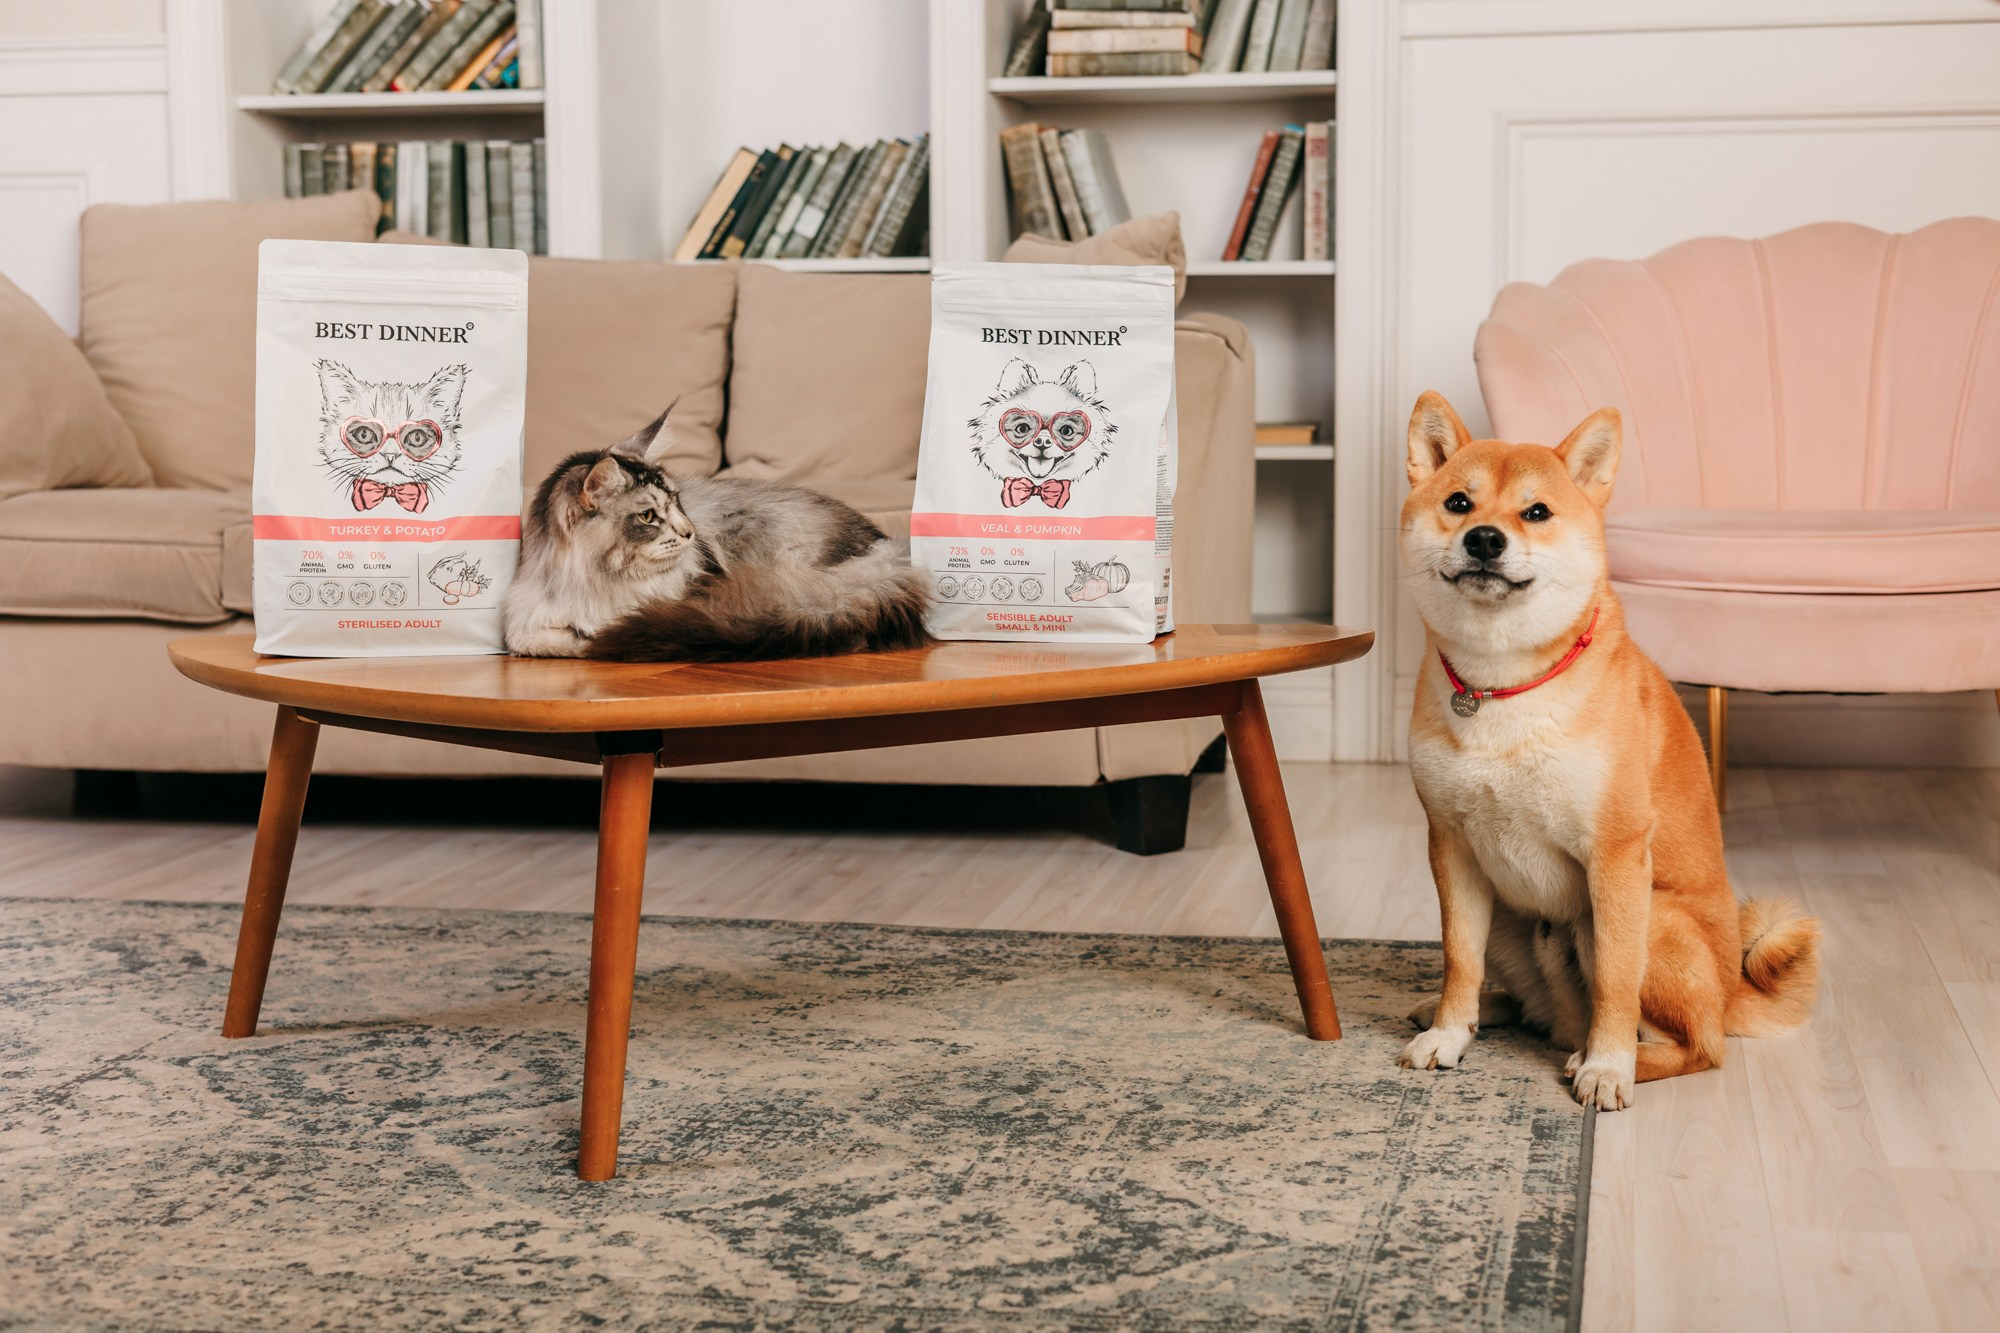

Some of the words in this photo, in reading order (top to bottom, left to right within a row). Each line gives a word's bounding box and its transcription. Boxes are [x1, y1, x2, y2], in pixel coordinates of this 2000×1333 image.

[315, 322, 372, 340] BEST
[379, 324, 469, 344] DINNER
[981, 327, 1032, 345] BEST
[1037, 329, 1122, 346] DINNER
[329, 525, 379, 536] TURKEY
[384, 525, 392, 536] &
[395, 525, 446, 537] POTATO
[980, 523, 1011, 534] VEAL
[1014, 524, 1022, 534] &
[1025, 524, 1082, 536] PUMPKIN
[302, 550, 324, 561] 70%
[337, 550, 354, 561] 0%
[370, 550, 386, 561] 0%
[949, 546, 969, 556] 73%
[981, 546, 995, 556] 0%
[1010, 547, 1025, 557] 0%
[986, 612, 1036, 622] SENSIBLE
[1038, 614, 1073, 623] ADULT
[338, 620, 402, 629] STERILISED
[404, 620, 442, 629] ADULT
[996, 623, 1031, 631] SMALL
[1033, 623, 1040, 632] &
[1042, 623, 1066, 632] MINI
